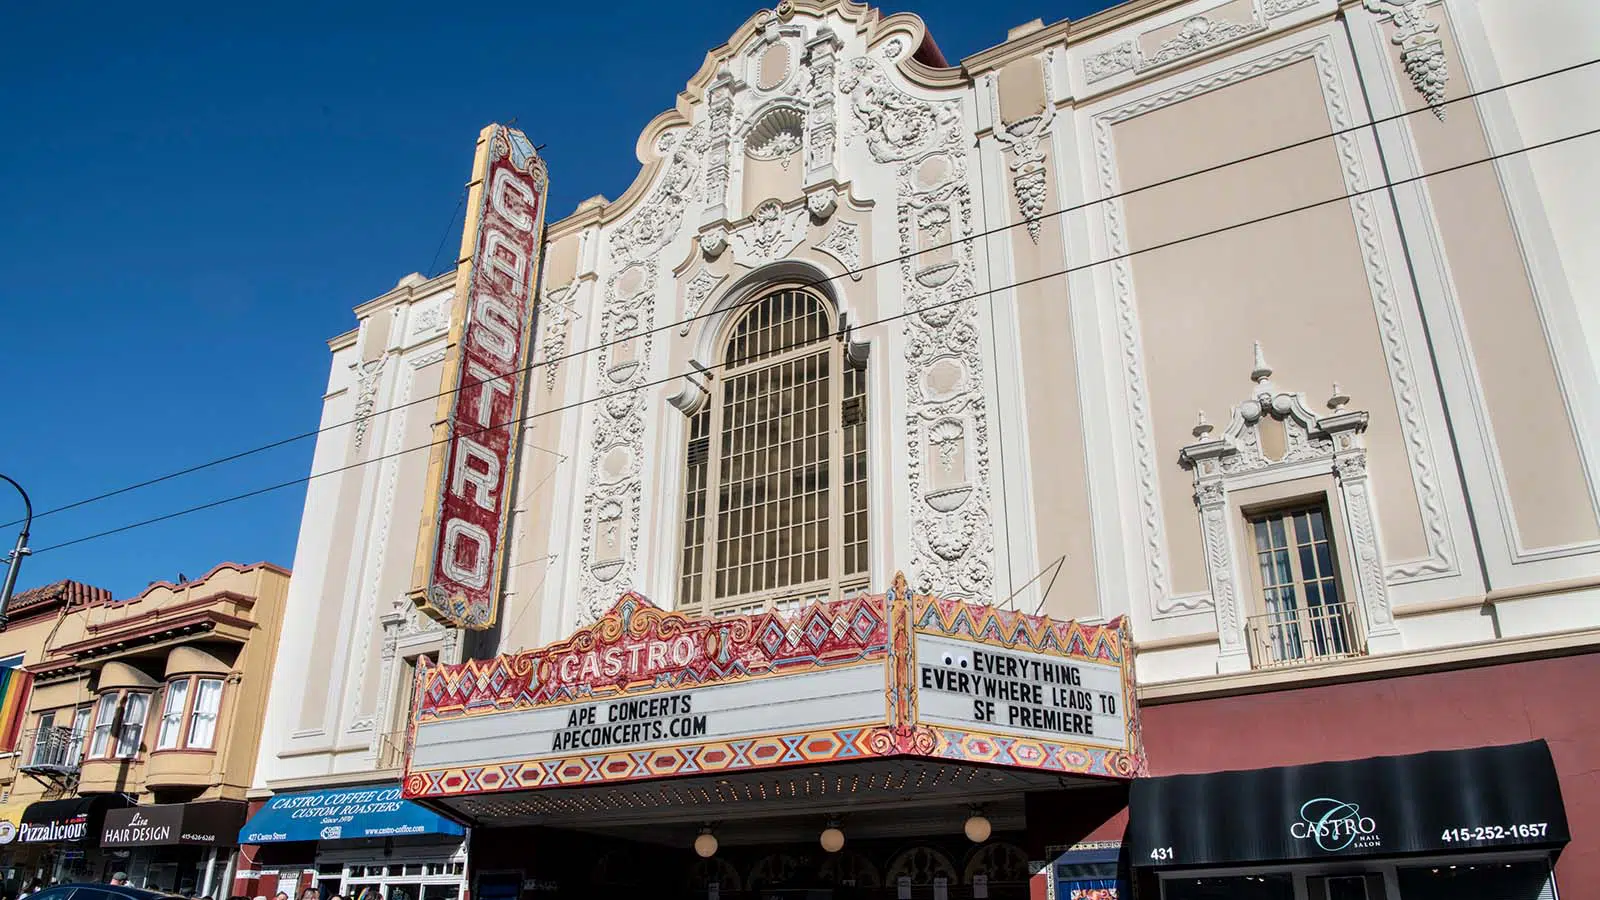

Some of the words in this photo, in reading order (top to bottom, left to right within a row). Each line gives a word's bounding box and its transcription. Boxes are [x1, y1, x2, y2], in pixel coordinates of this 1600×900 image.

[441, 166, 535, 590] CASTRO
[561, 634, 696, 682] CASTRO
[973, 651, 1081, 687] EVERYTHING
[922, 668, 1043, 704] EVERYWHERE
[1052, 688, 1093, 712] LEADS
[1099, 695, 1116, 715] TO
[567, 704, 596, 728] APE
[607, 694, 692, 722] CONCERTS
[974, 700, 996, 722] SF
[1009, 706, 1094, 735] PREMIERE
[552, 715, 706, 751] APECONCERTS.COM
[272, 795, 324, 810] CASTRO
[324, 791, 376, 806] COFFEE
[291, 806, 339, 819] CUSTOM
[340, 801, 404, 815] ROASTERS
[17, 818, 88, 842] Pizzalicious
[320, 817, 338, 825] Since
[1290, 816, 1376, 839] CASTRO
[104, 829, 130, 843] HAIR
[132, 826, 171, 842] DESIGN
[272, 832, 287, 840] Street
[1359, 834, 1381, 842] NAIL
[1441, 822, 1548, 844] 415-252-1657
[1150, 846, 1174, 860] 431
